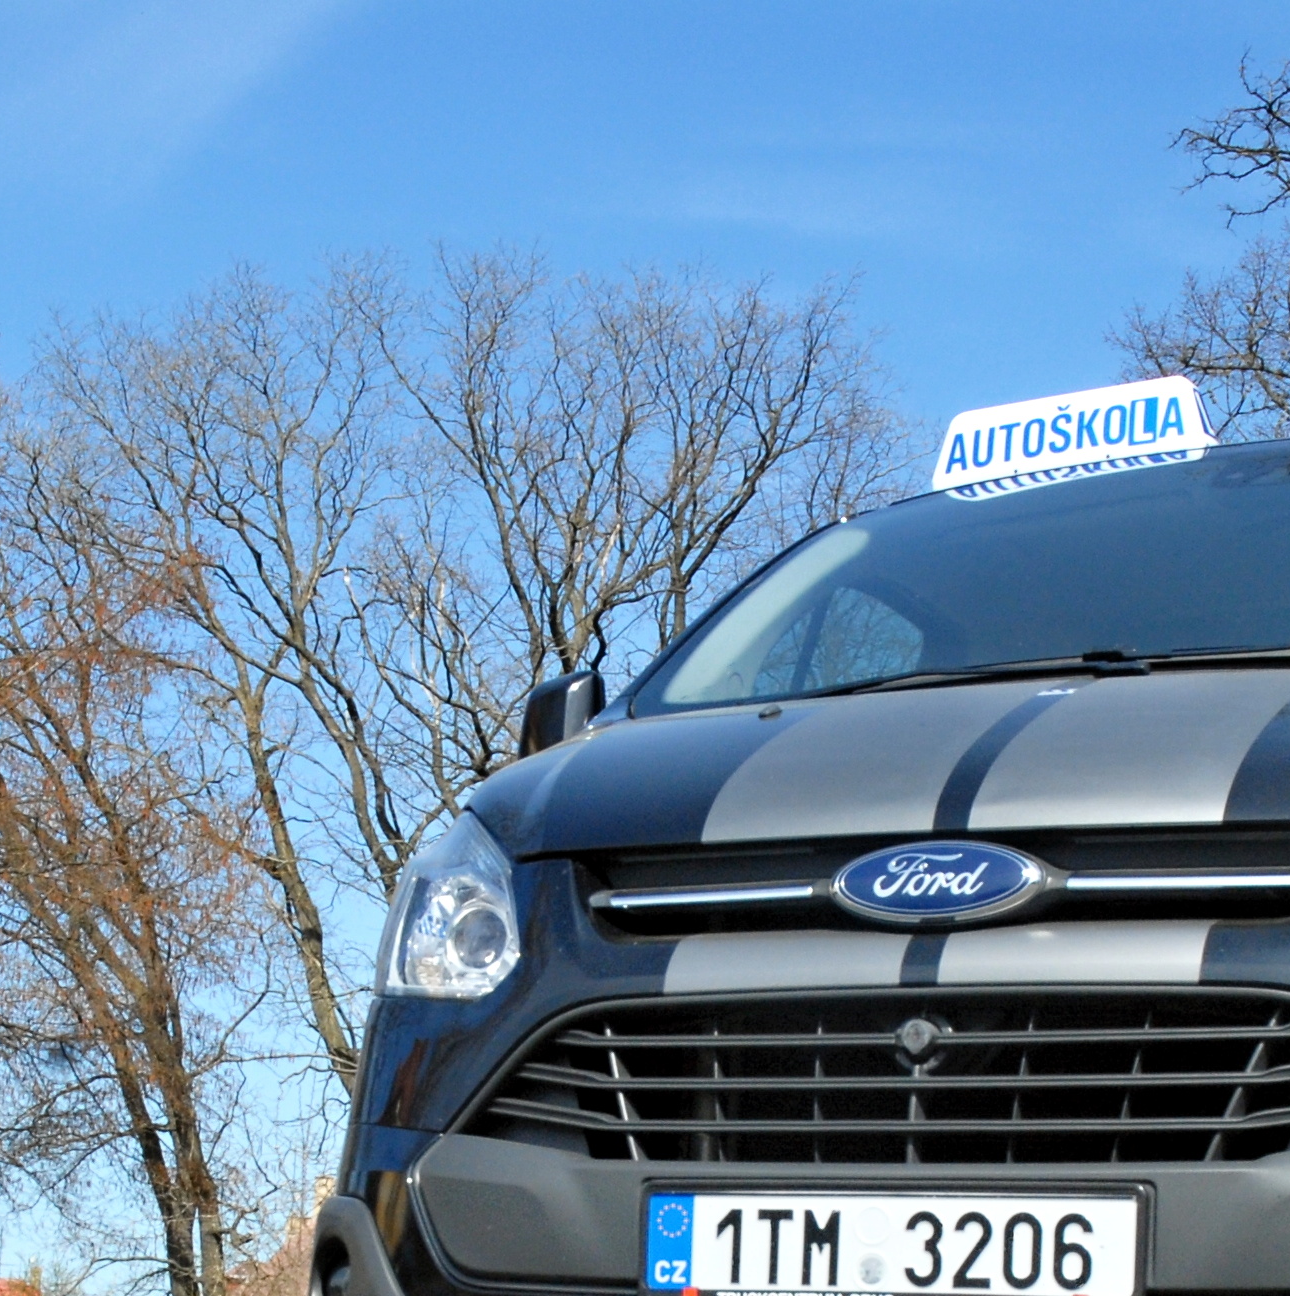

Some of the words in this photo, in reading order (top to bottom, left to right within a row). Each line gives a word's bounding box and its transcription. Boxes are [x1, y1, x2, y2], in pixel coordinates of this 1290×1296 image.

[944, 396, 1185, 475] AUTOŠKOLA
[872, 852, 990, 898] Ford
[654, 1259, 688, 1284] CZ
[715, 1208, 841, 1287] 1TM
[904, 1210, 1094, 1291] 3206
